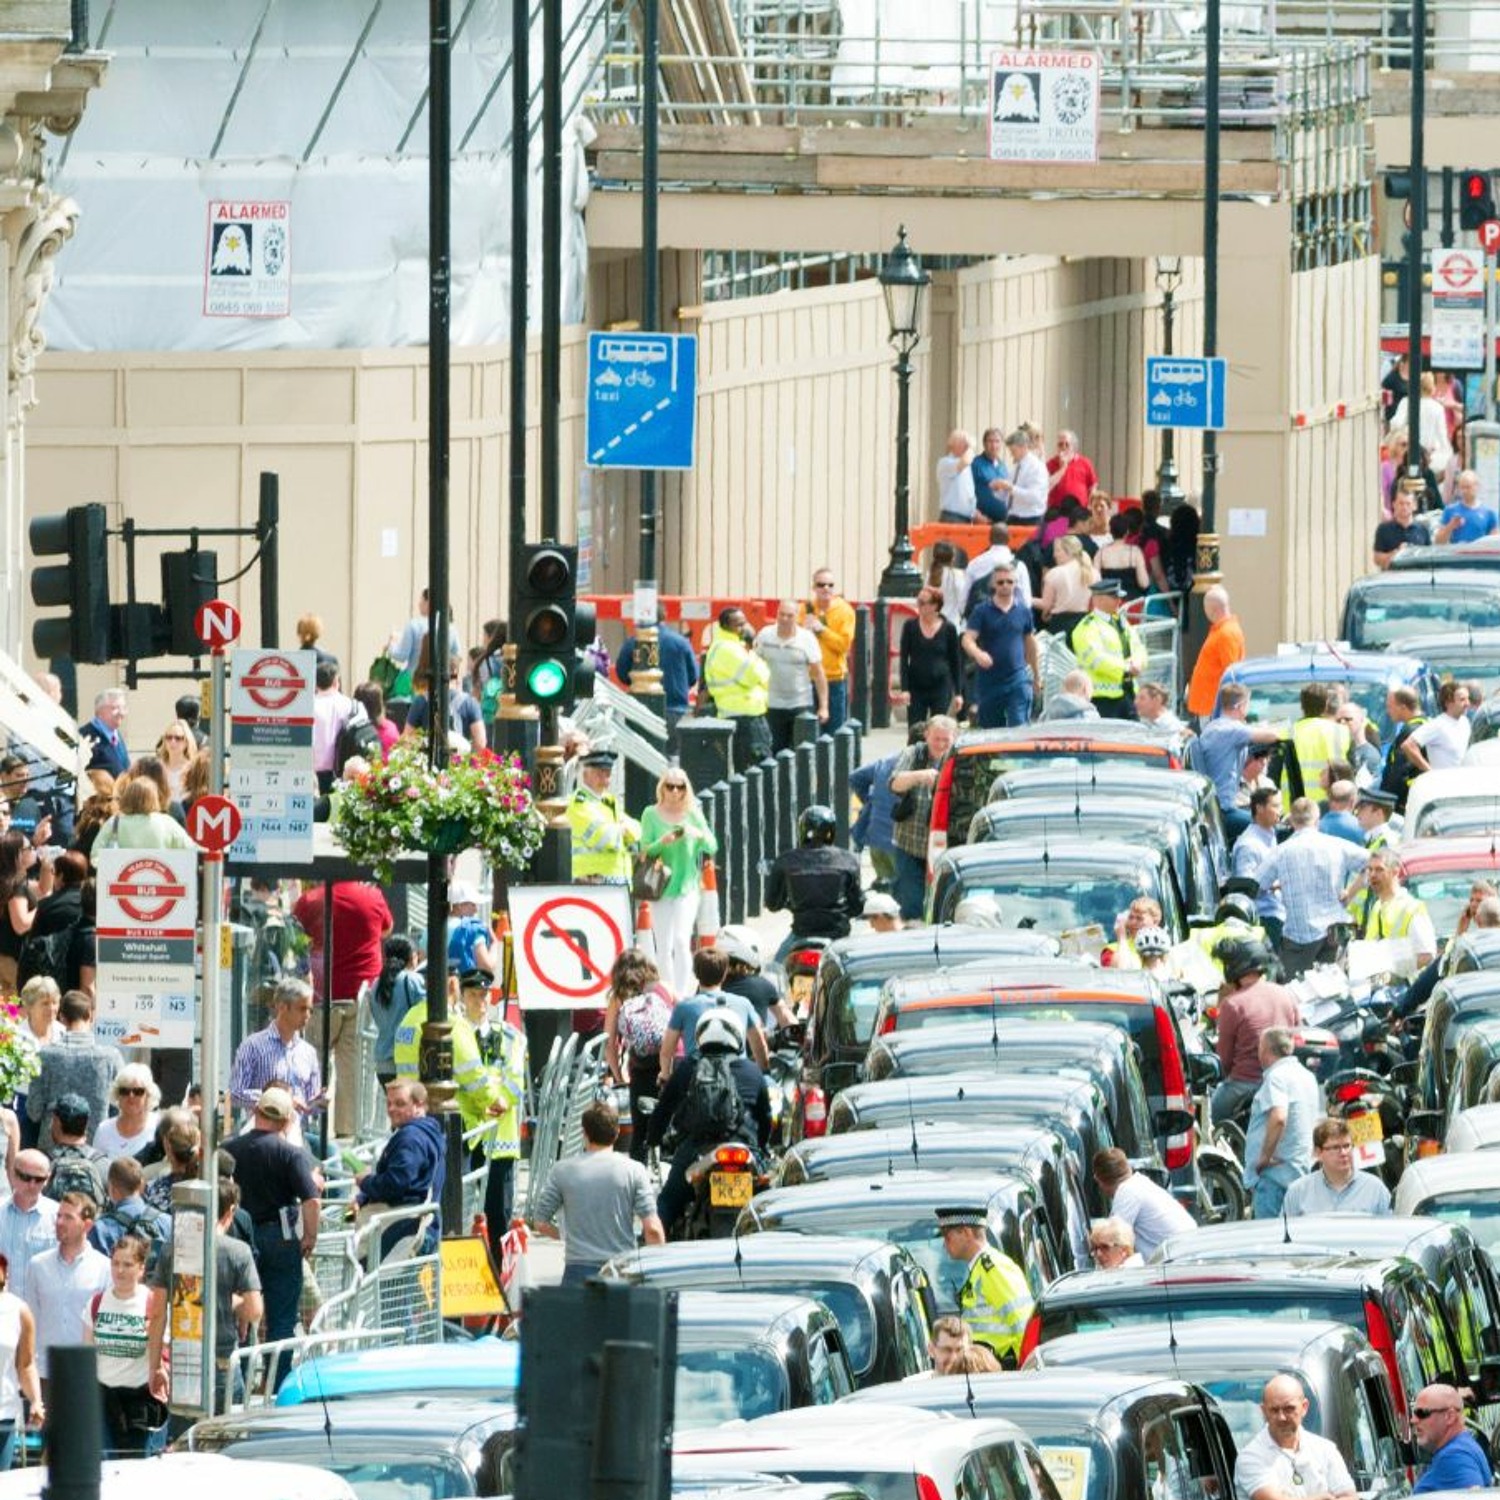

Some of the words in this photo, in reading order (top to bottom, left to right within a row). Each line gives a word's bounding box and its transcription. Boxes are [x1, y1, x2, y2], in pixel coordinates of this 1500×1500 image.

[999, 53, 1093, 69] ALARMED
[217, 204, 287, 219] ALARMED
[1485, 223, 1500, 246] P
[595, 388, 620, 401] taxi
[202, 607, 234, 641] N
[292, 798, 307, 809] N2
[196, 805, 232, 841] M
[261, 821, 281, 832] N44
[137, 884, 157, 896] BUS
[123, 943, 169, 953] Whitehall
[134, 1000, 154, 1010] 159
[169, 1001, 187, 1011] N3
[96, 1026, 127, 1036] N109
[1359, 1145, 1377, 1160] L
